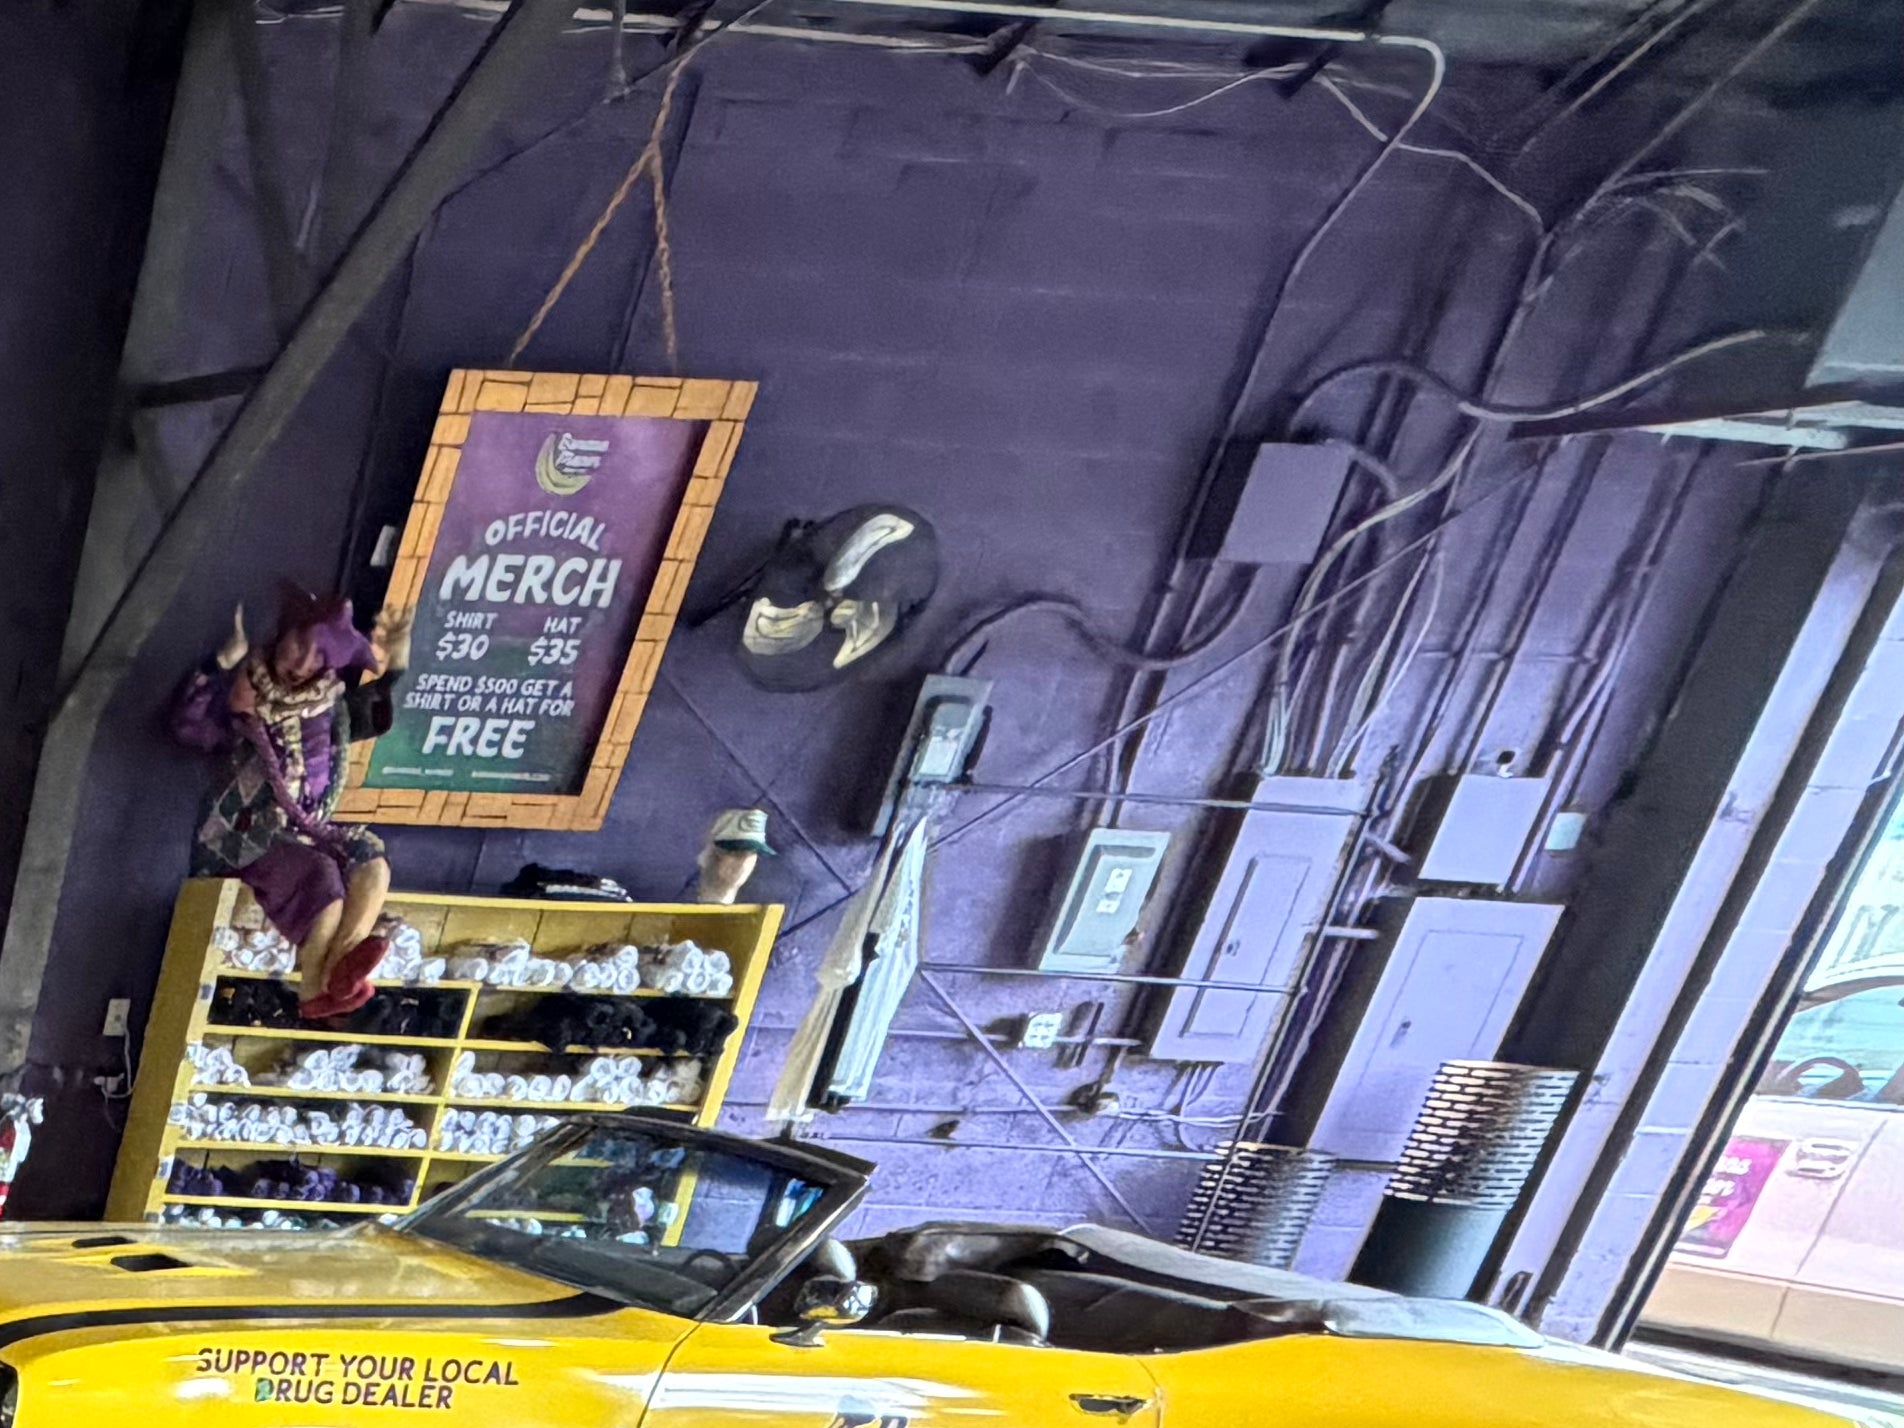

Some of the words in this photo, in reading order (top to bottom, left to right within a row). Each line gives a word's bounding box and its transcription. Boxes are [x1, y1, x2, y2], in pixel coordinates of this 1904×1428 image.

[485, 510, 606, 551] OFFICIAL
[439, 553, 622, 608] MERCH
[444, 610, 498, 629] SHIRT
[543, 616, 582, 634] HAT
[436, 631, 490, 661] $30
[528, 636, 581, 667] $35
[416, 673, 473, 691] SPEND
[474, 676, 517, 695] $500
[521, 679, 558, 697] GET
[560, 681, 573, 698] A
[403, 691, 456, 710] SHIRT
[457, 695, 483, 712] OR
[485, 696, 497, 713] A
[500, 699, 536, 716] HAT
[539, 699, 575, 717] FOR
[421, 715, 536, 759] FREE
[195, 1347, 330, 1377] SUPPORT
[340, 1353, 415, 1381] YOUR
[424, 1357, 519, 1386] LOCAL
[254, 1376, 334, 1404] DRUG
[341, 1380, 453, 1409] DEALER
